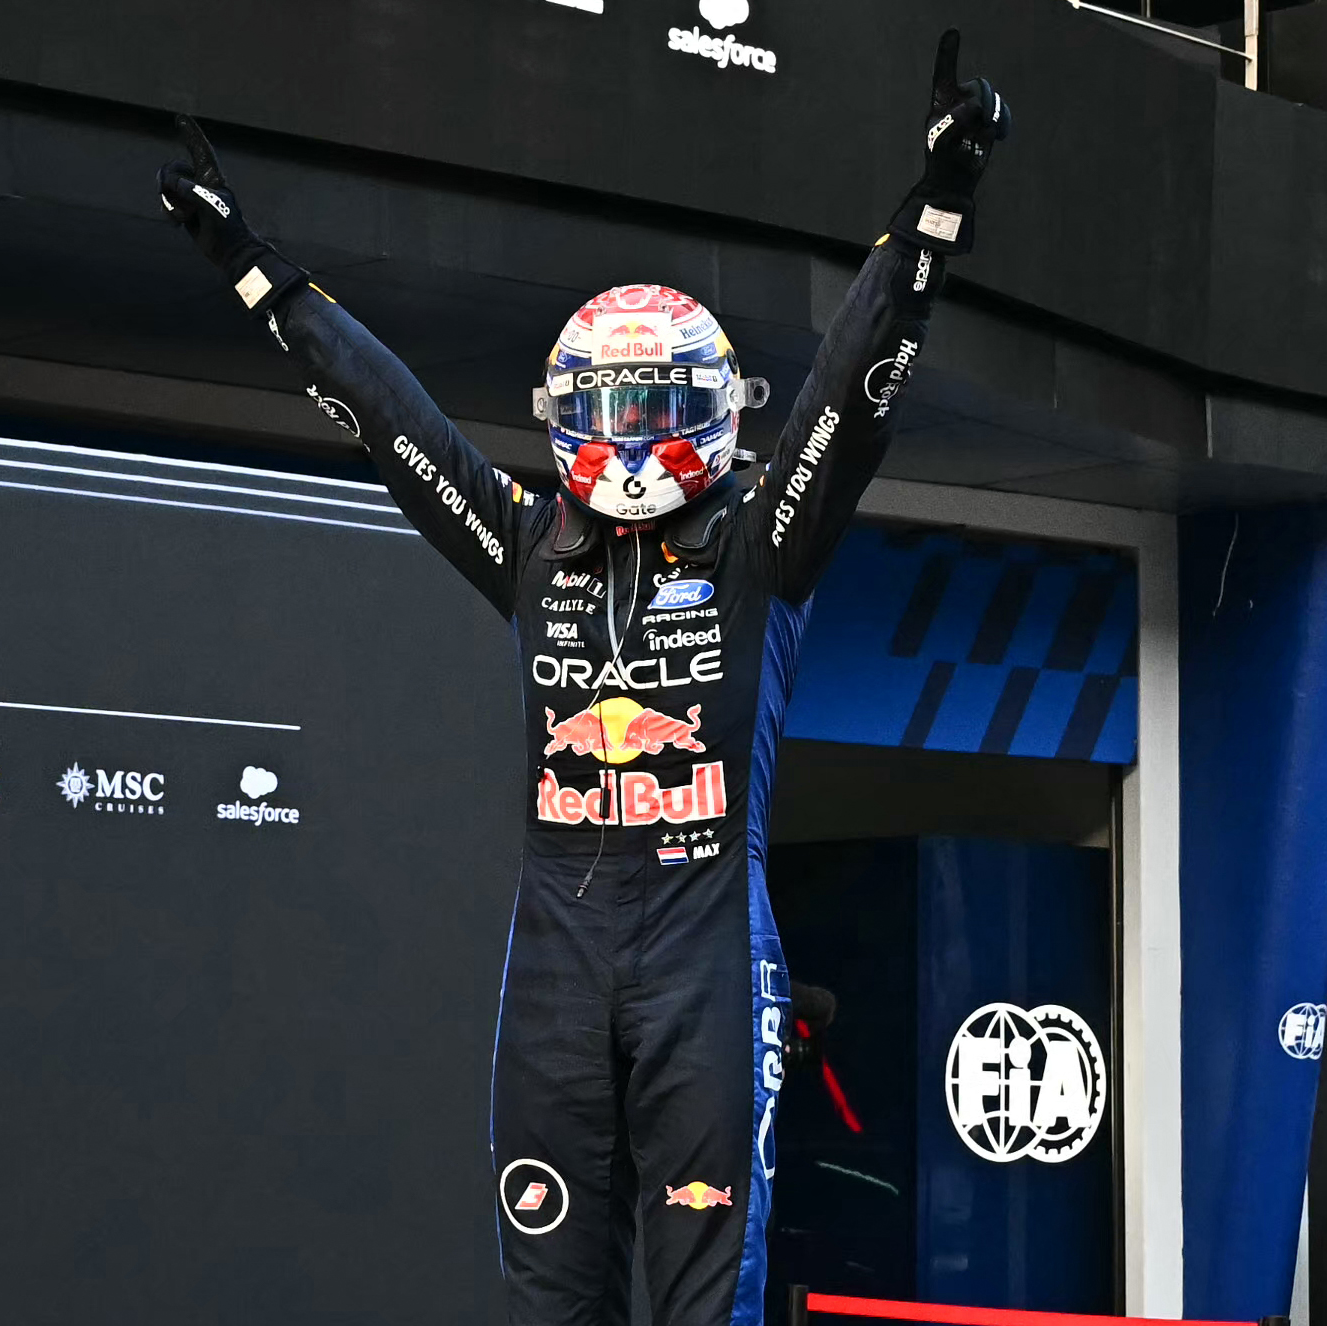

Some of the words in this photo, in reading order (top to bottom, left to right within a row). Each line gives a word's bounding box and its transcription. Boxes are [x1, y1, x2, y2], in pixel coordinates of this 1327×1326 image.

[668, 26, 776, 74] salesforce
[633, 342, 663, 356] Bull
[890, 339, 918, 380] Hard
[576, 367, 688, 389] ORACLE
[874, 382, 900, 418] Rock
[785, 463, 812, 501] YOU
[800, 405, 840, 465] WINGS
[393, 435, 436, 482] GIVES
[435, 475, 466, 515] YOU
[465, 508, 504, 565] WINGS
[656, 583, 702, 606] Ford
[642, 608, 719, 625] RACING
[546, 622, 578, 639] VISA
[648, 624, 722, 651] indeed
[532, 649, 724, 690] ORACLE
[95, 769, 164, 801] MSC
[537, 767, 619, 826] Red
[620, 760, 727, 827] Bull
[95, 802, 164, 815] CRUISES
[216, 800, 299, 826] salesforce
[693, 843, 720, 860] MAX
